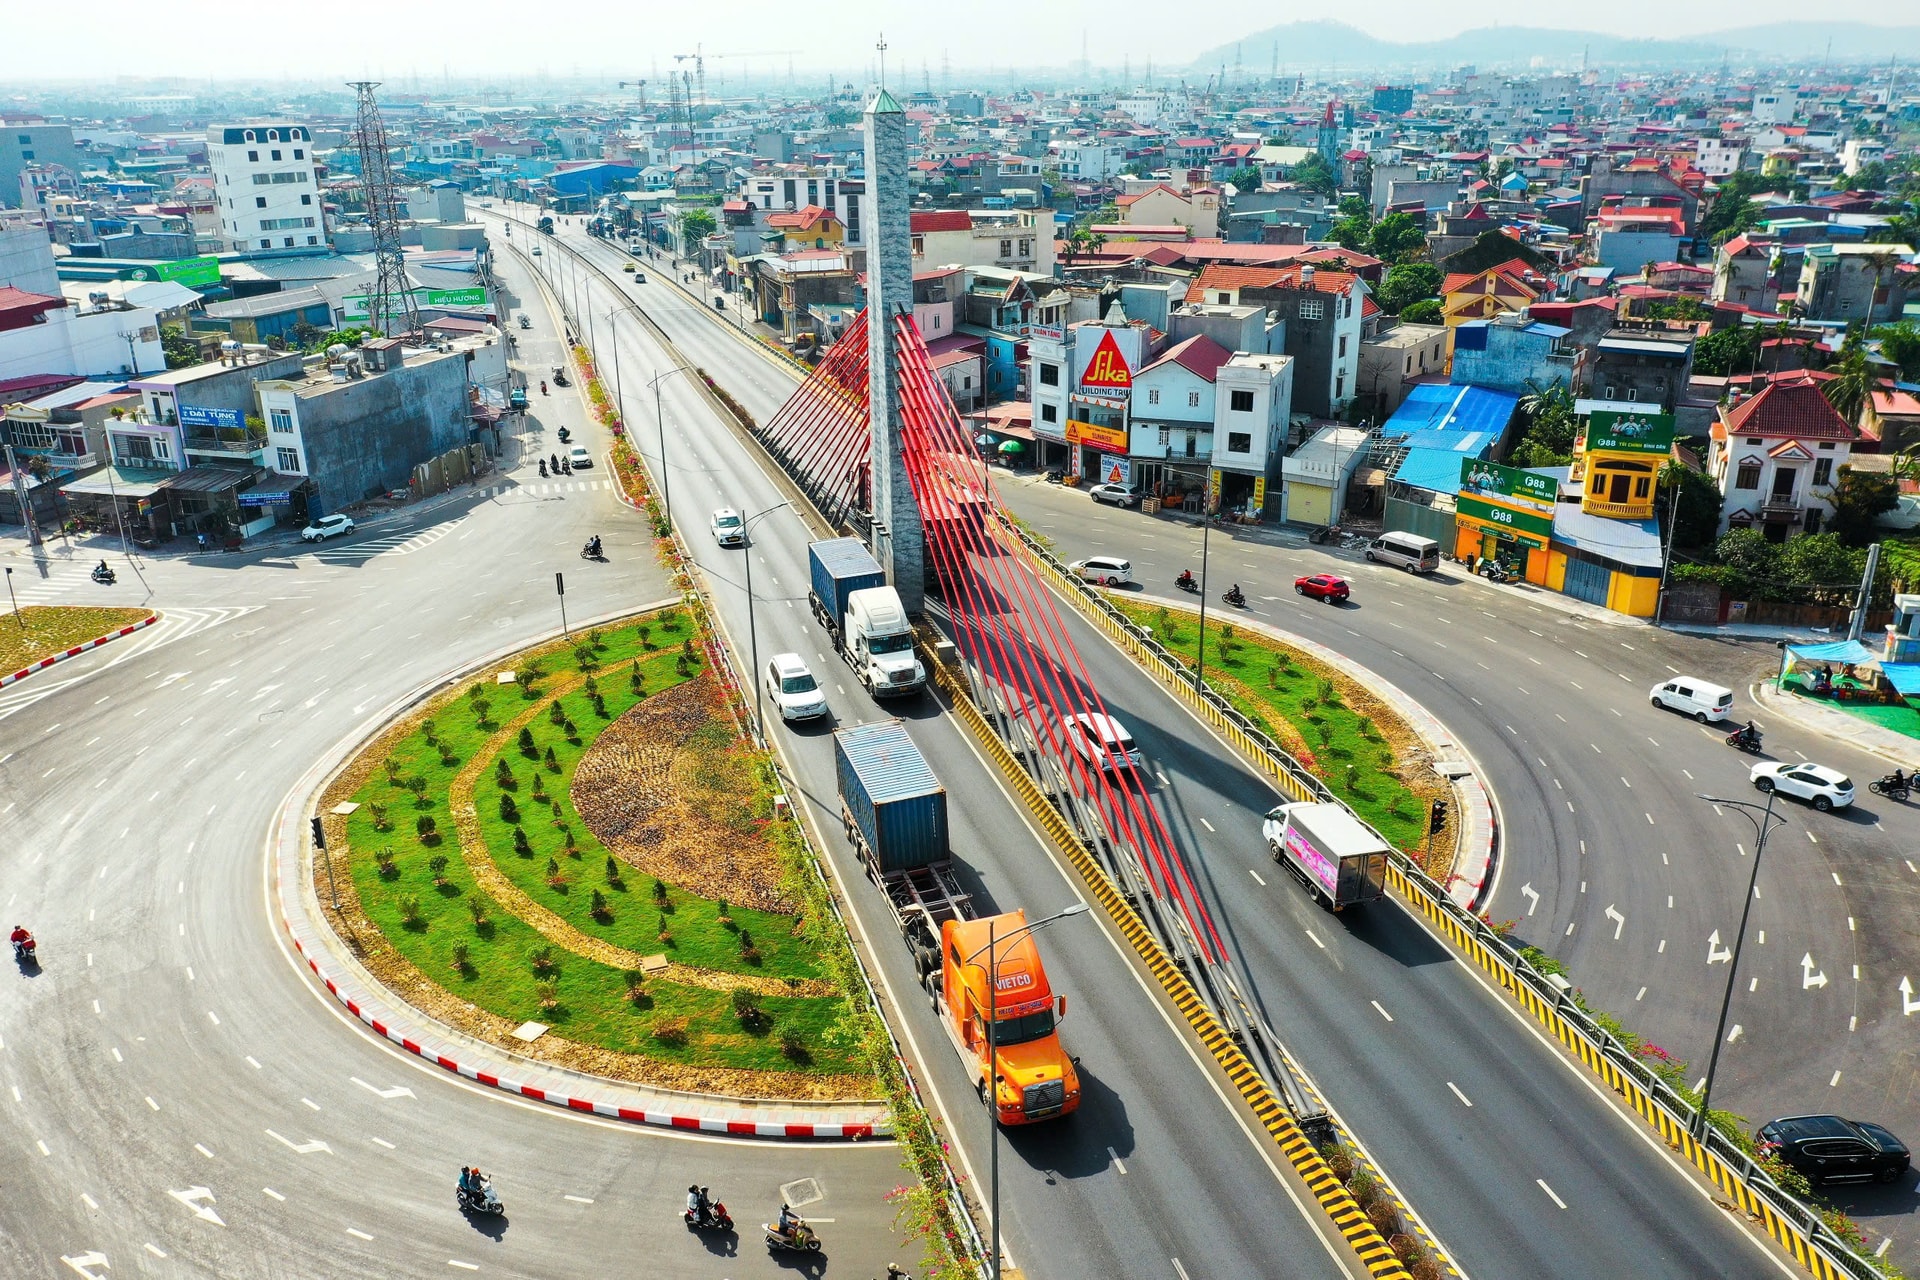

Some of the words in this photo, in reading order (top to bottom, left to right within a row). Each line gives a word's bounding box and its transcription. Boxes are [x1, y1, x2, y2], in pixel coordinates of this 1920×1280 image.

[1086, 350, 1127, 382] Sika
[1080, 387, 1112, 396] UILDING
[1598, 438, 1616, 446] F88
[1525, 476, 1545, 489] F88
[1491, 508, 1512, 523] F88
[996, 974, 1031, 990] VIETCO
